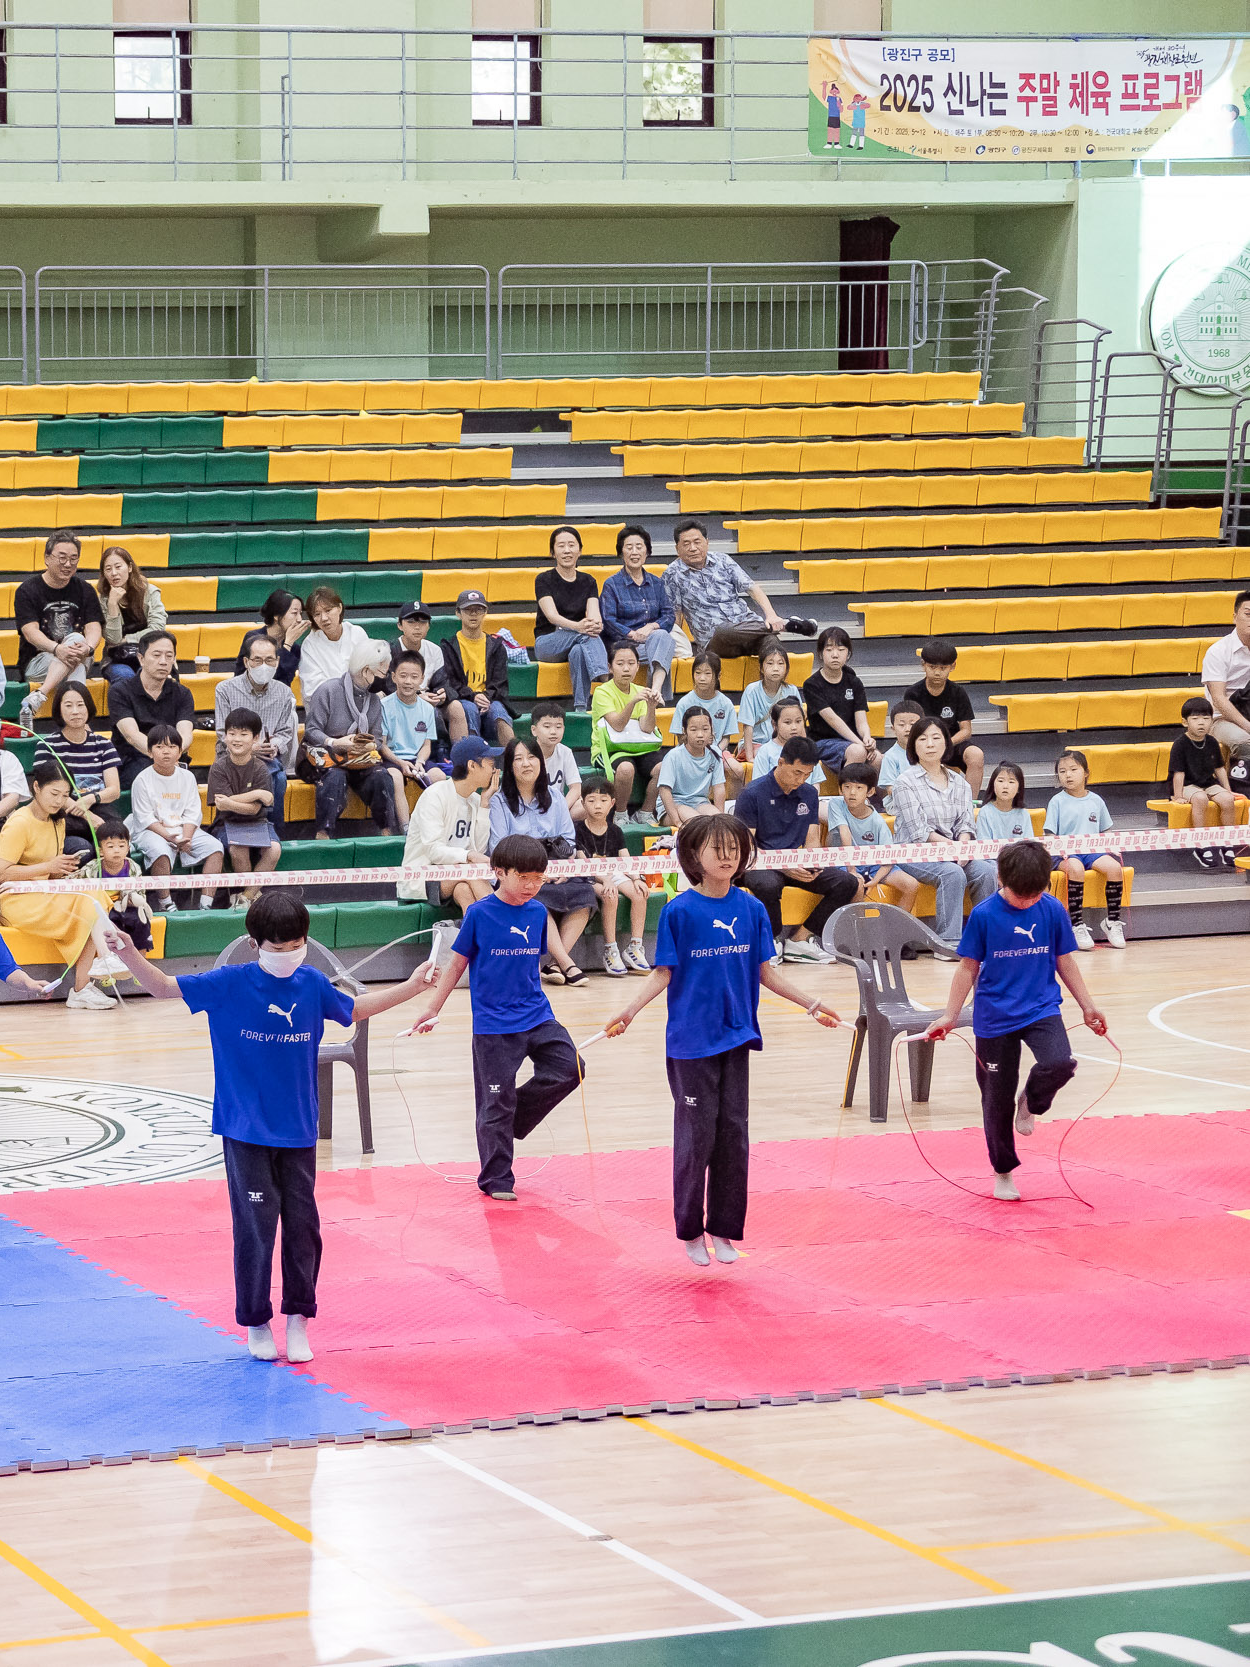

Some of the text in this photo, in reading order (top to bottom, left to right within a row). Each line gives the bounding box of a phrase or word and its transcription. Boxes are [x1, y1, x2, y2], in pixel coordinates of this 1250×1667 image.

[882, 47, 956, 63] [광진구 공모]
[880, 69, 1203, 117] 2025 신나는 주말 체육 프로그램
[1208, 348, 1231, 358] 1968
